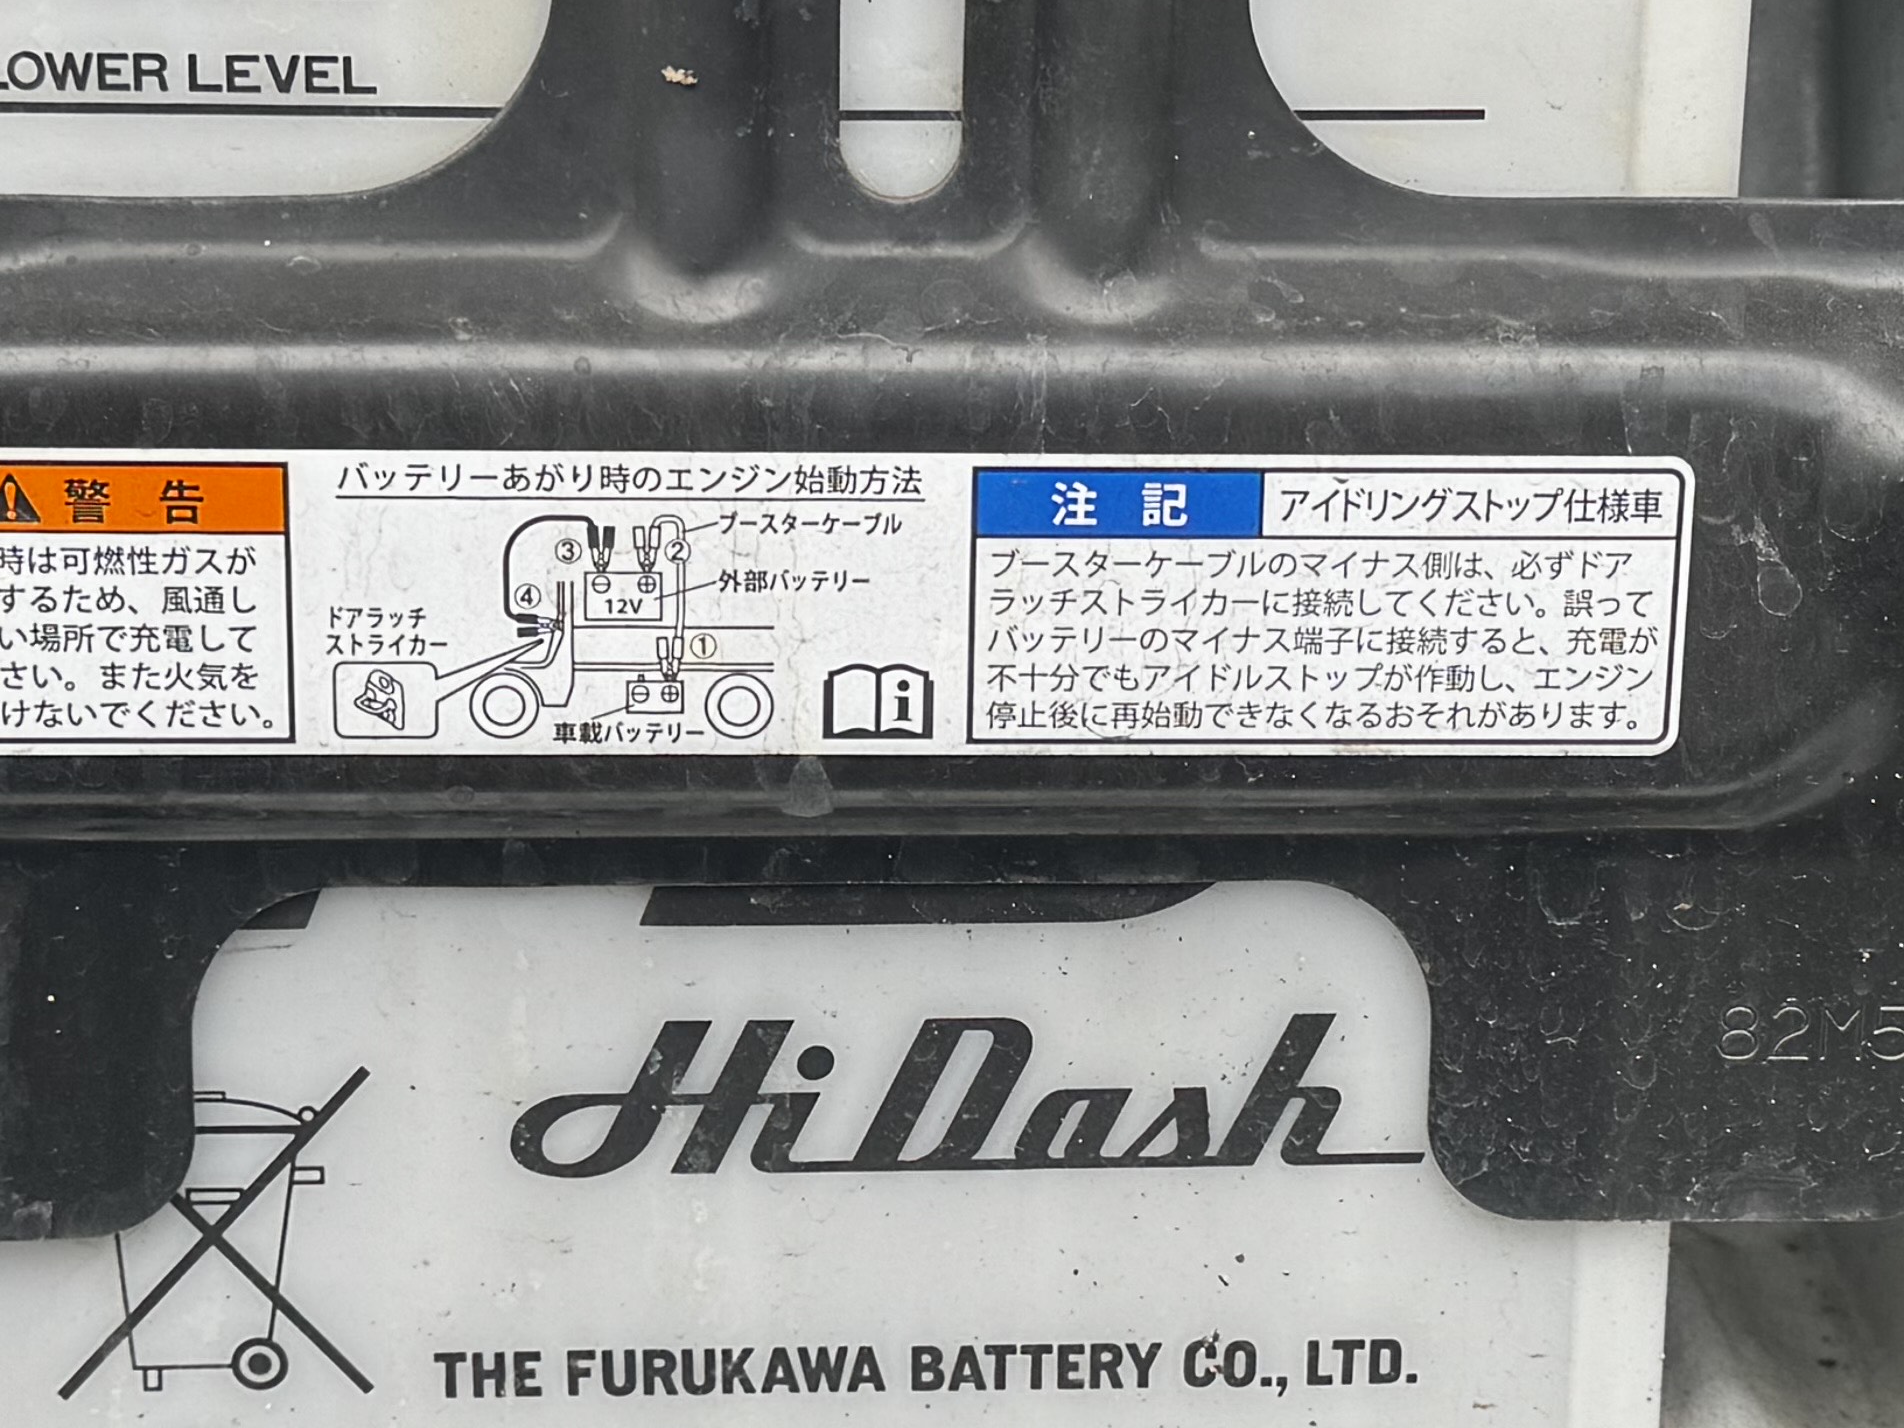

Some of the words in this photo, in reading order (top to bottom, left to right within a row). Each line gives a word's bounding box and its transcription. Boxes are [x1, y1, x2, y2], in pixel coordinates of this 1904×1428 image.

[188, 54, 377, 95] LEVEL
[337, 462, 923, 495] バッテリーあがり時のエンジン始動方法
[1280, 487, 1663, 524] アイドリングストップ仕様車
[720, 513, 902, 535] ブースターケーブル
[990, 548, 1633, 580] ブースターケーブルのマイナス側は、必ずドア
[718, 570, 871, 594] 外部バッテリー
[328, 606, 427, 628] ドアラッチ
[604, 598, 643, 614] 12V
[989, 587, 1654, 618] ラッチストライカーに接続してください。誤って
[325, 633, 448, 656] ストライカー
[987, 625, 1658, 656] バッテリーのマイナス端子に接続すると、充電が
[987, 663, 1653, 693] 不十分でもアイドルストップが作動し、エンジン
[986, 701, 1640, 731] 停止後に再始動できなくなるおそれがあります。
[553, 721, 705, 745] 車載バッテリー
[434, 1350, 543, 1400] THE
[568, 1345, 885, 1398] FURUKAWA
[911, 1342, 1161, 1393] BATTERY
[1184, 1338, 1288, 1397] CO.,
[1306, 1338, 1419, 1387] LTD.
